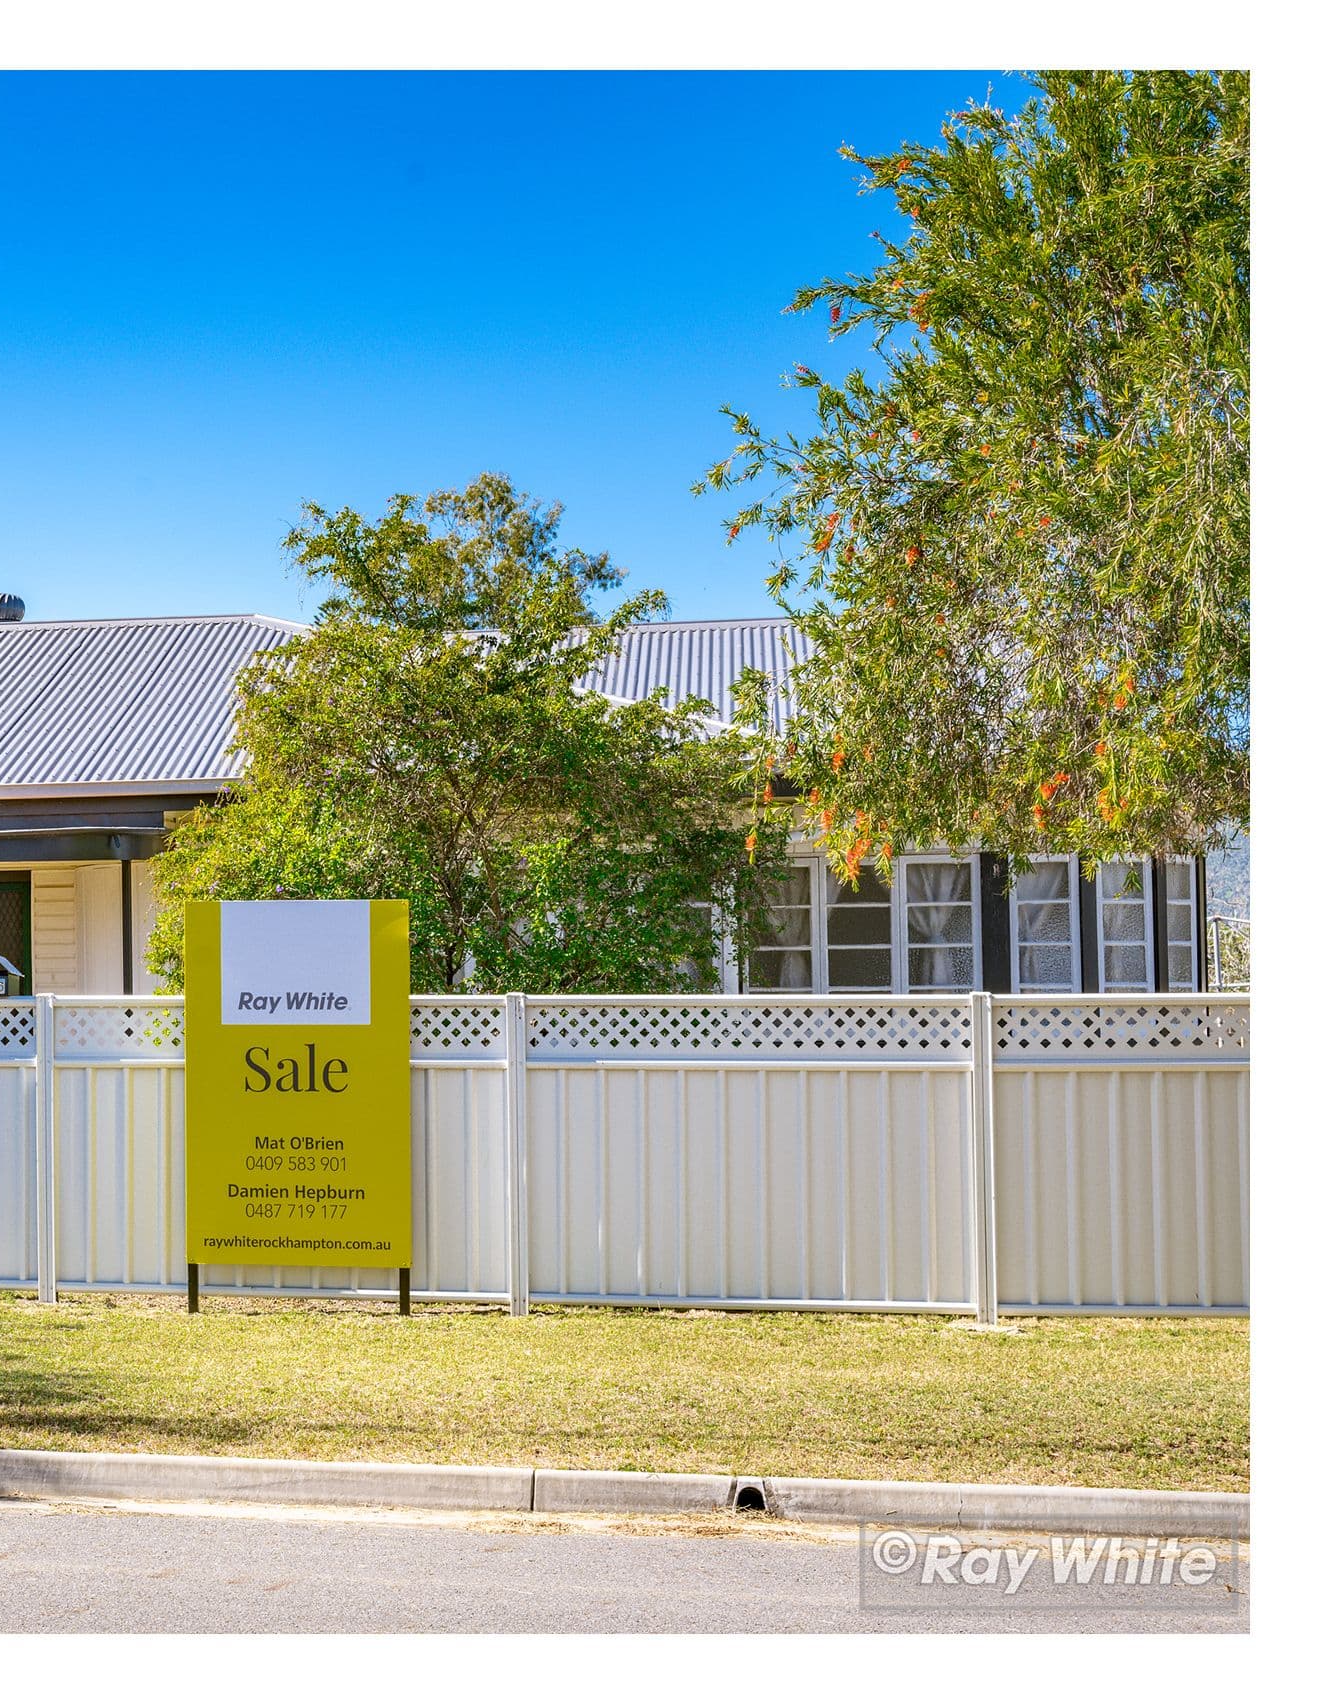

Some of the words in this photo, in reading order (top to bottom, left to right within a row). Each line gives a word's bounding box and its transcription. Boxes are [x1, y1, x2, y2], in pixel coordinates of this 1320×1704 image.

[238, 992, 282, 1014] Ray
[286, 992, 348, 1011] White
[244, 1043, 348, 1093] Sale
[255, 1136, 286, 1150] Mat
[290, 1136, 344, 1151] O'Brien
[245, 1156, 283, 1171] 0409
[288, 1156, 316, 1172] 583
[320, 1157, 347, 1172] 901
[228, 1183, 289, 1199] Damien
[295, 1184, 365, 1201] Hepburn
[245, 1203, 282, 1218] 0487
[288, 1204, 316, 1219] 719
[321, 1204, 348, 1220] 177
[203, 1235, 392, 1252] raywhiterockhampton.com.au
